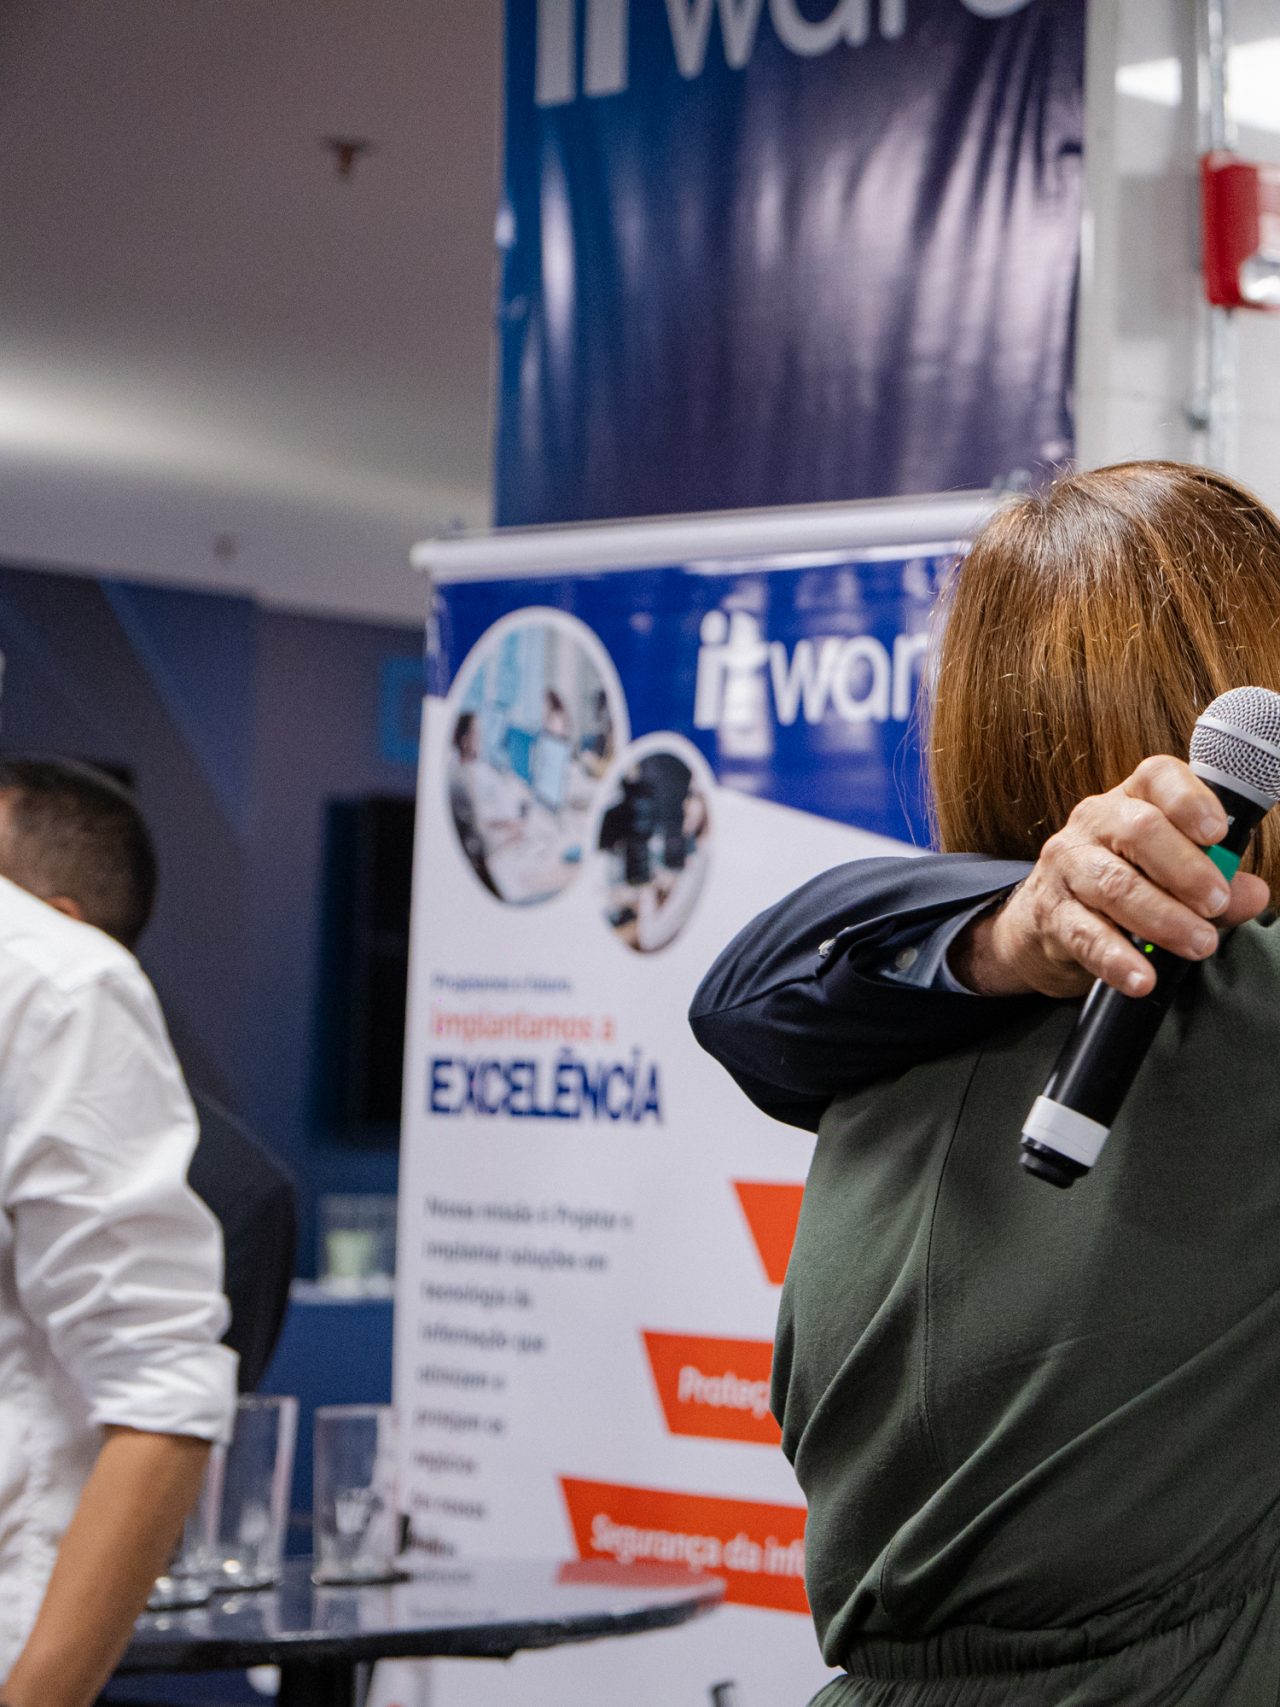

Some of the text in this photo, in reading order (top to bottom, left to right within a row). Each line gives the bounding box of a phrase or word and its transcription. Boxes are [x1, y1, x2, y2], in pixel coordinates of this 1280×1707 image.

[430, 1047, 663, 1122] EXCELÊNCIA
[591, 1513, 722, 1573] Segurança
[724, 1533, 761, 1573] da
